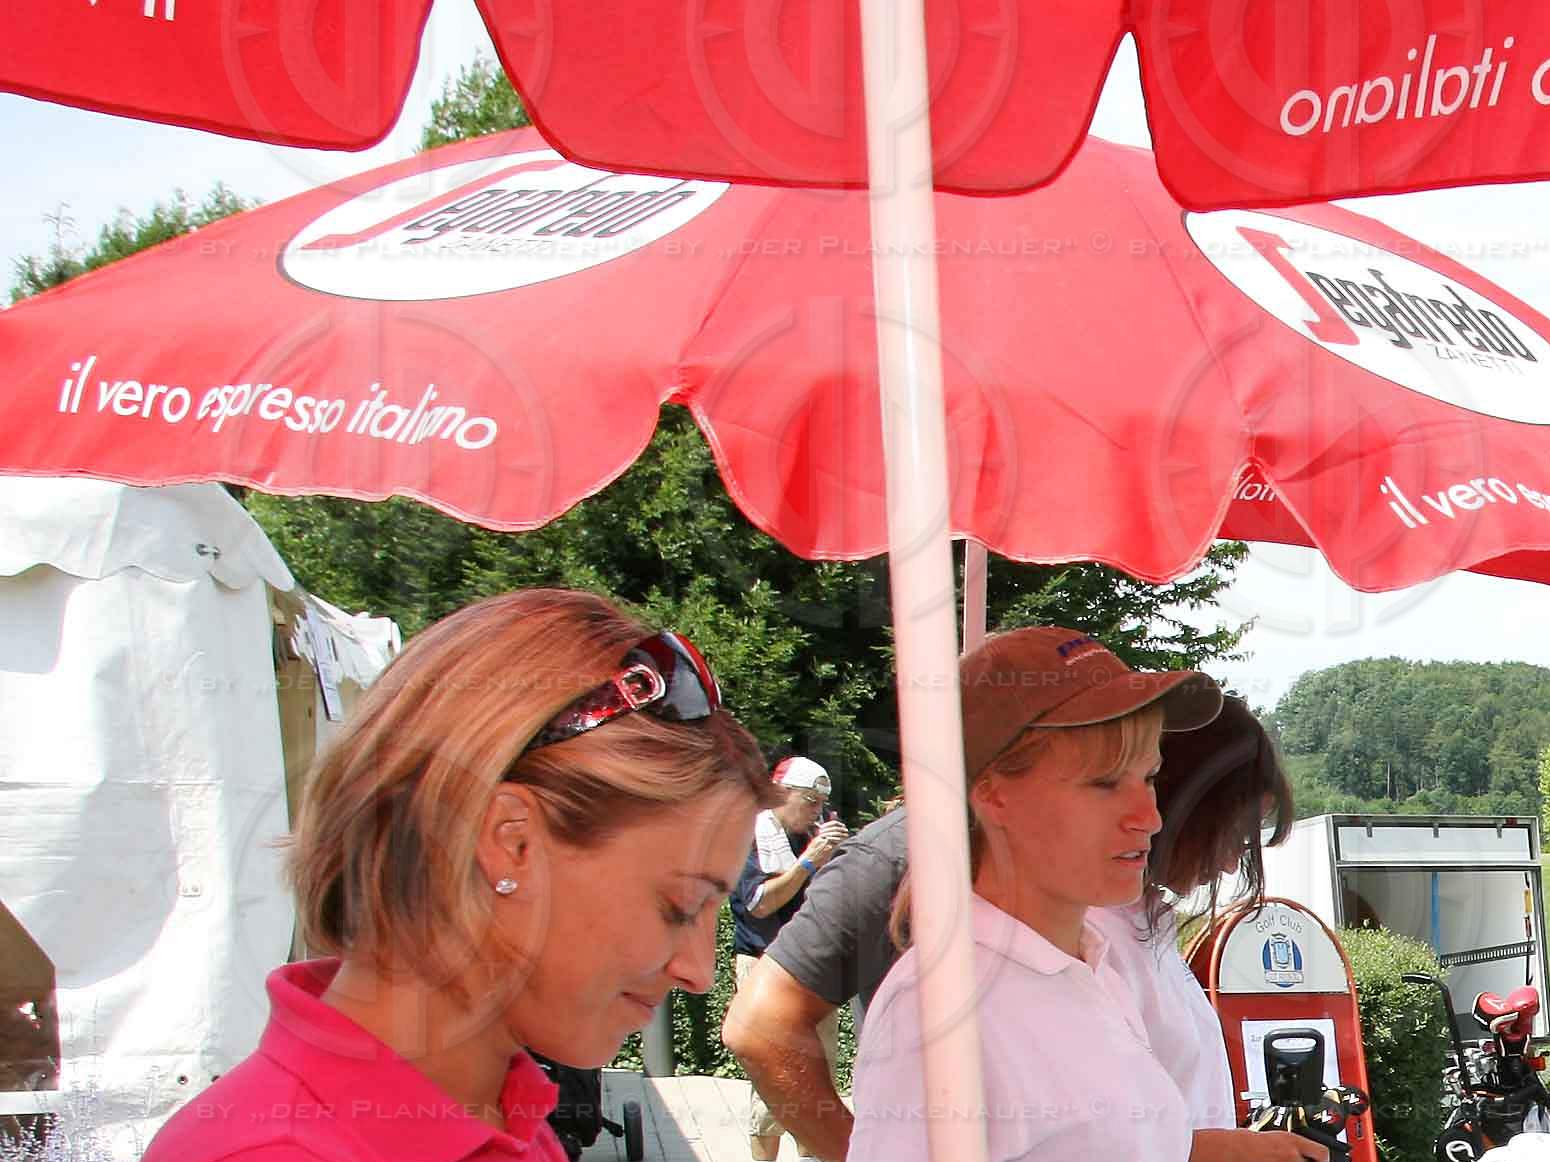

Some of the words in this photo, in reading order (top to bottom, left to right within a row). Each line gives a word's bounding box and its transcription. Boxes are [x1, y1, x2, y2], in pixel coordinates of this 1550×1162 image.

[58, 355, 97, 414] il
[98, 379, 192, 423] vero
[196, 383, 346, 433] espresso
[1379, 475, 1429, 529] il
[1421, 477, 1518, 519] vero
[1256, 911, 1275, 933] Golf
[1279, 914, 1302, 933] Club
